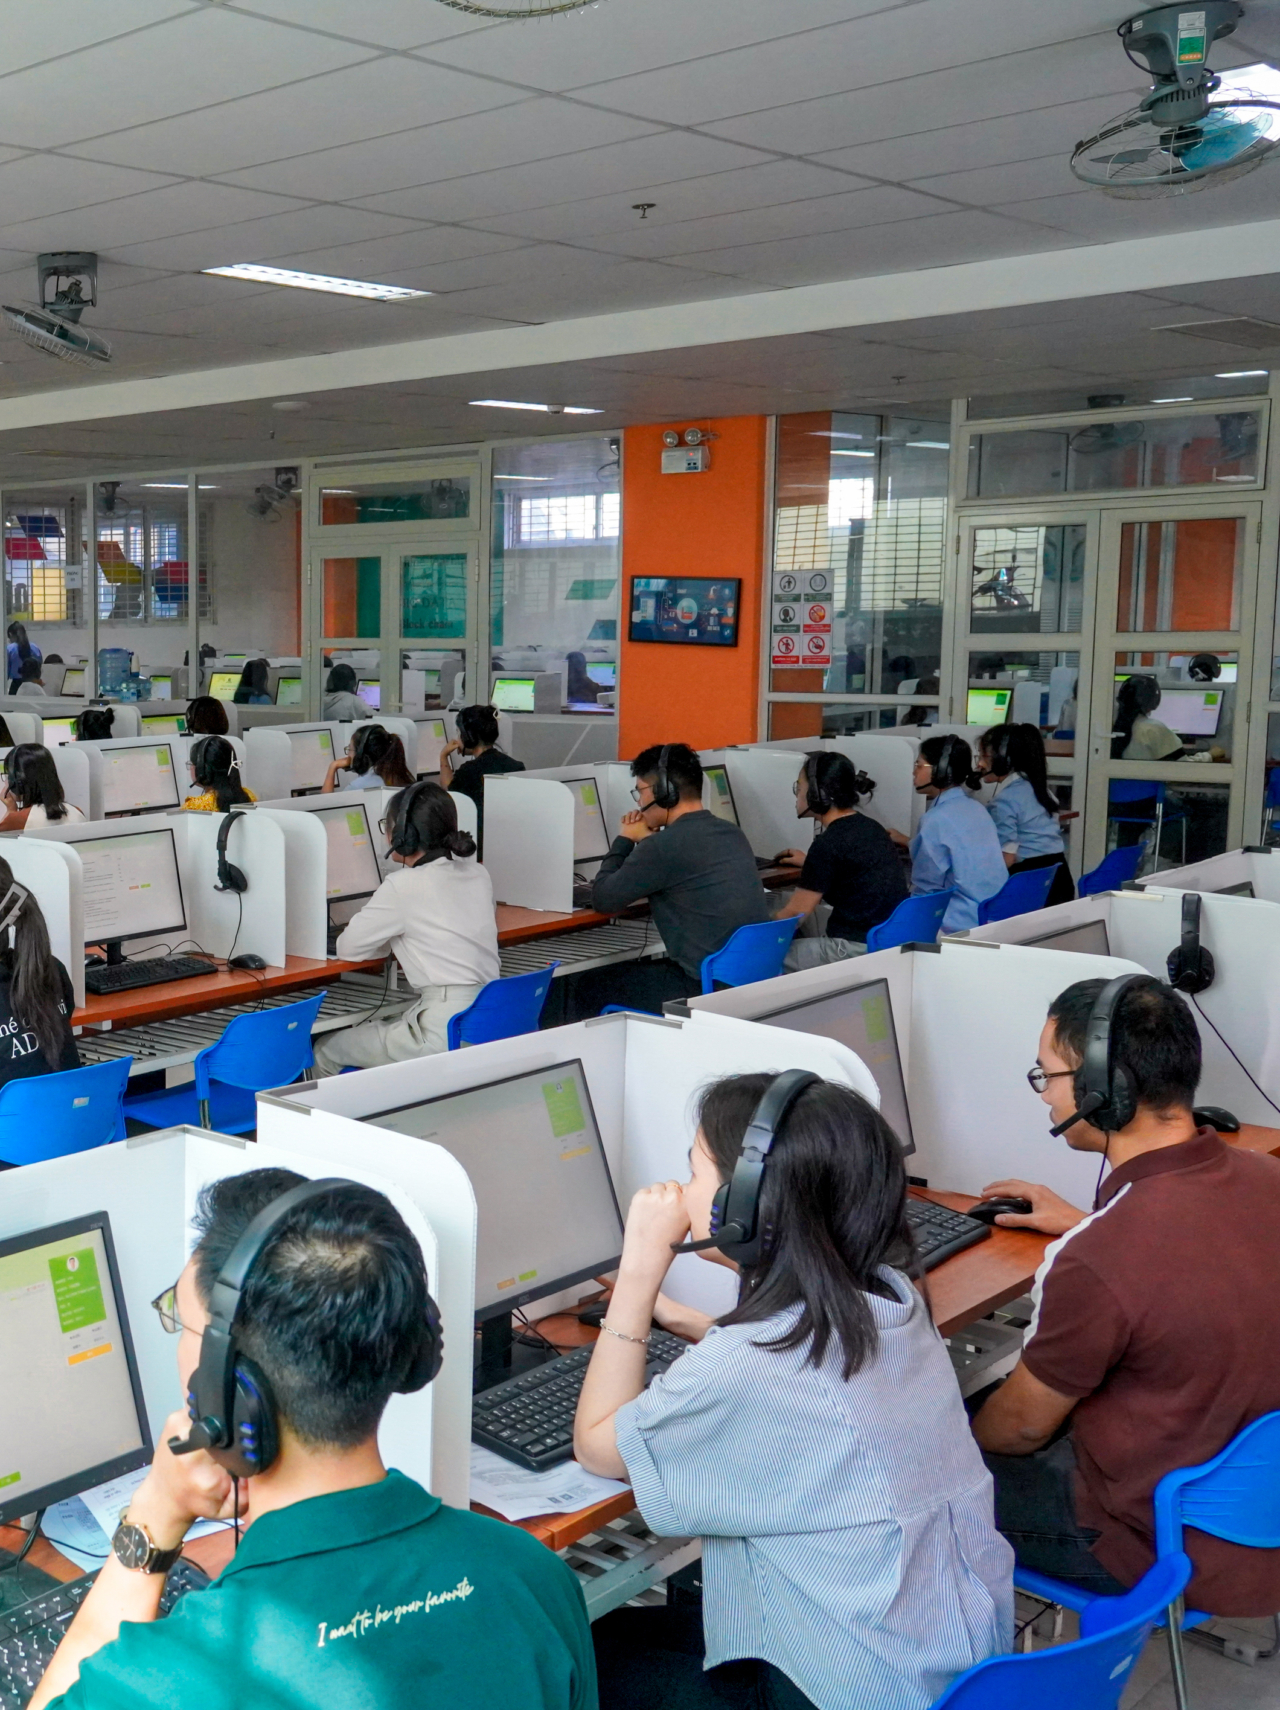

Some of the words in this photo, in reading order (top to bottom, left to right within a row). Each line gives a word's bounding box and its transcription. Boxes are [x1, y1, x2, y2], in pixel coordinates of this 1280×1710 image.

[317, 1622, 328, 1647] I
[329, 1611, 361, 1638] want
[359, 1609, 373, 1636] to
[374, 1604, 393, 1628] be
[393, 1600, 424, 1624] your
[425, 1576, 474, 1613] favorite
